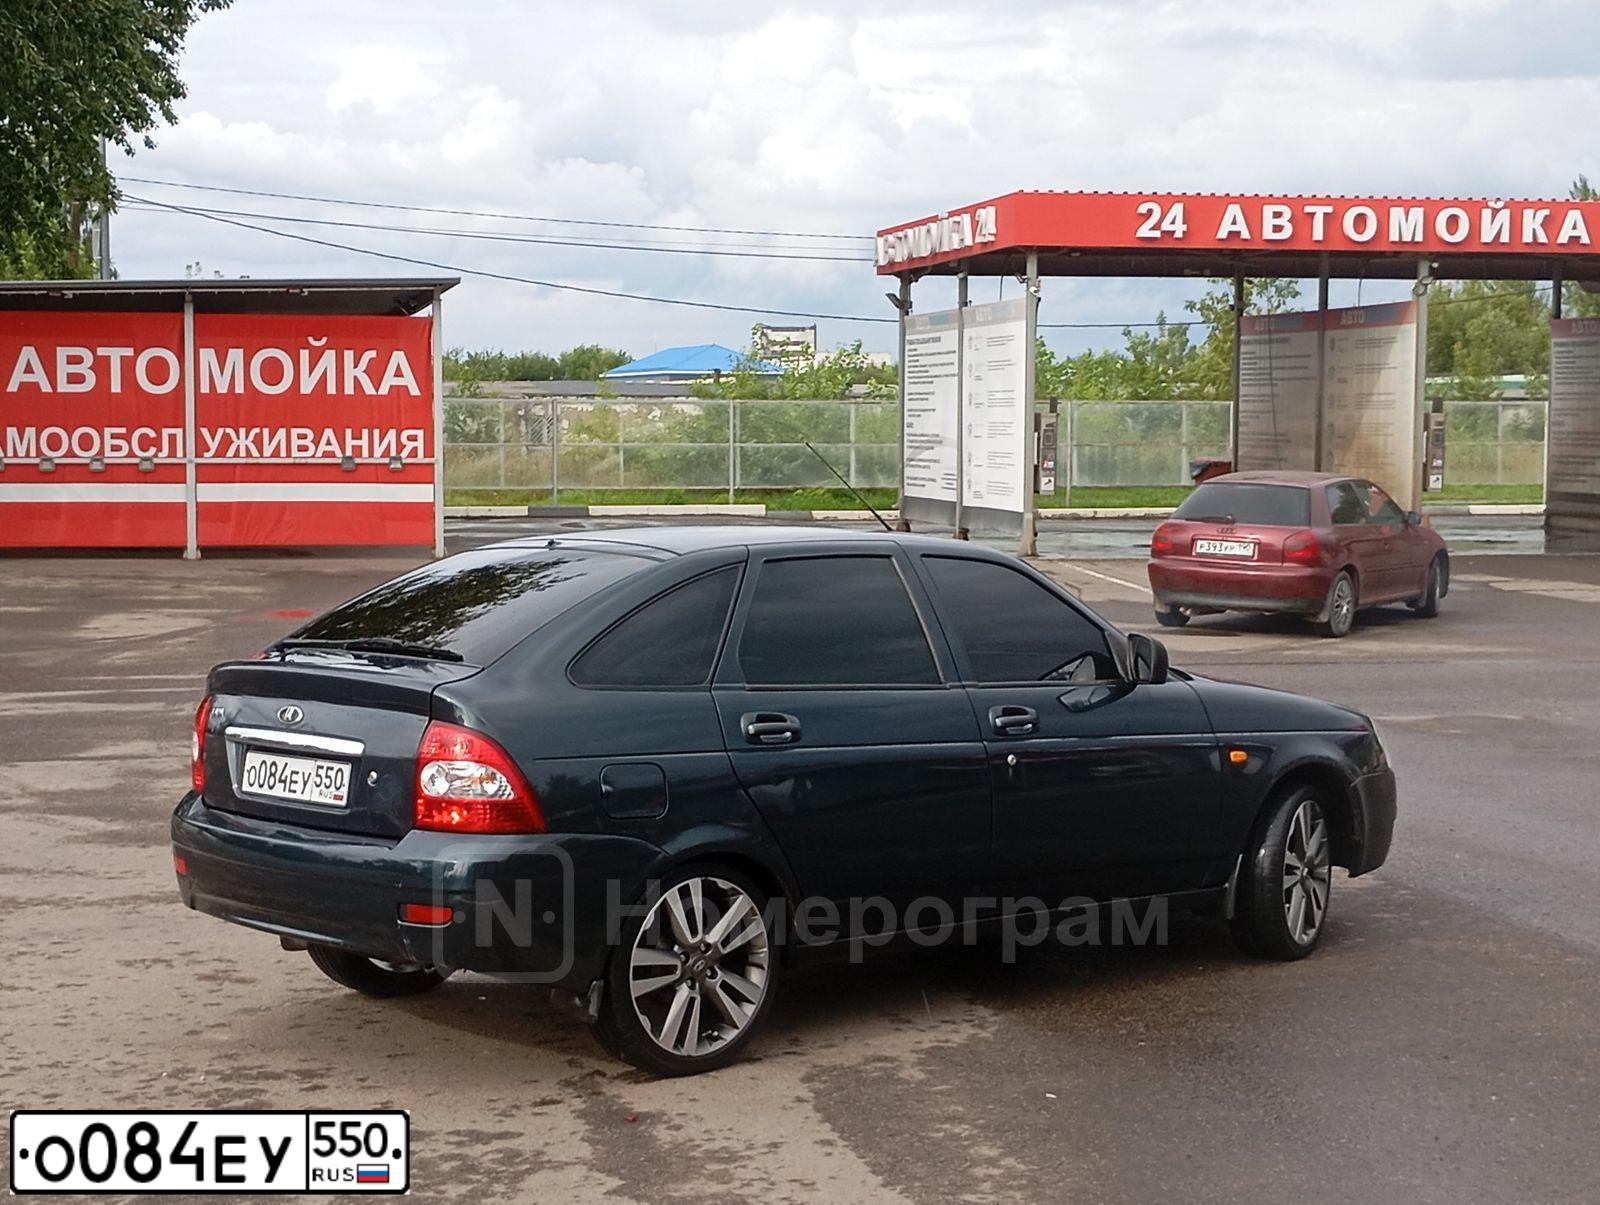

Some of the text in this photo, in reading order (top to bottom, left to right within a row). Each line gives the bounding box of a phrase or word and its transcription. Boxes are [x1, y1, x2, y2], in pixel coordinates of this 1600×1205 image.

[975, 206, 996, 244] 24
[1136, 201, 1591, 245] 24 АВТОМОЙКА
[1340, 310, 1366, 326] АВТО
[6, 336, 422, 397] АВТОМОЙКА
[0, 426, 425, 459] МООБСЛУЖИВАНИЯ
[247, 760, 345, 795] О084ЕУ 550
